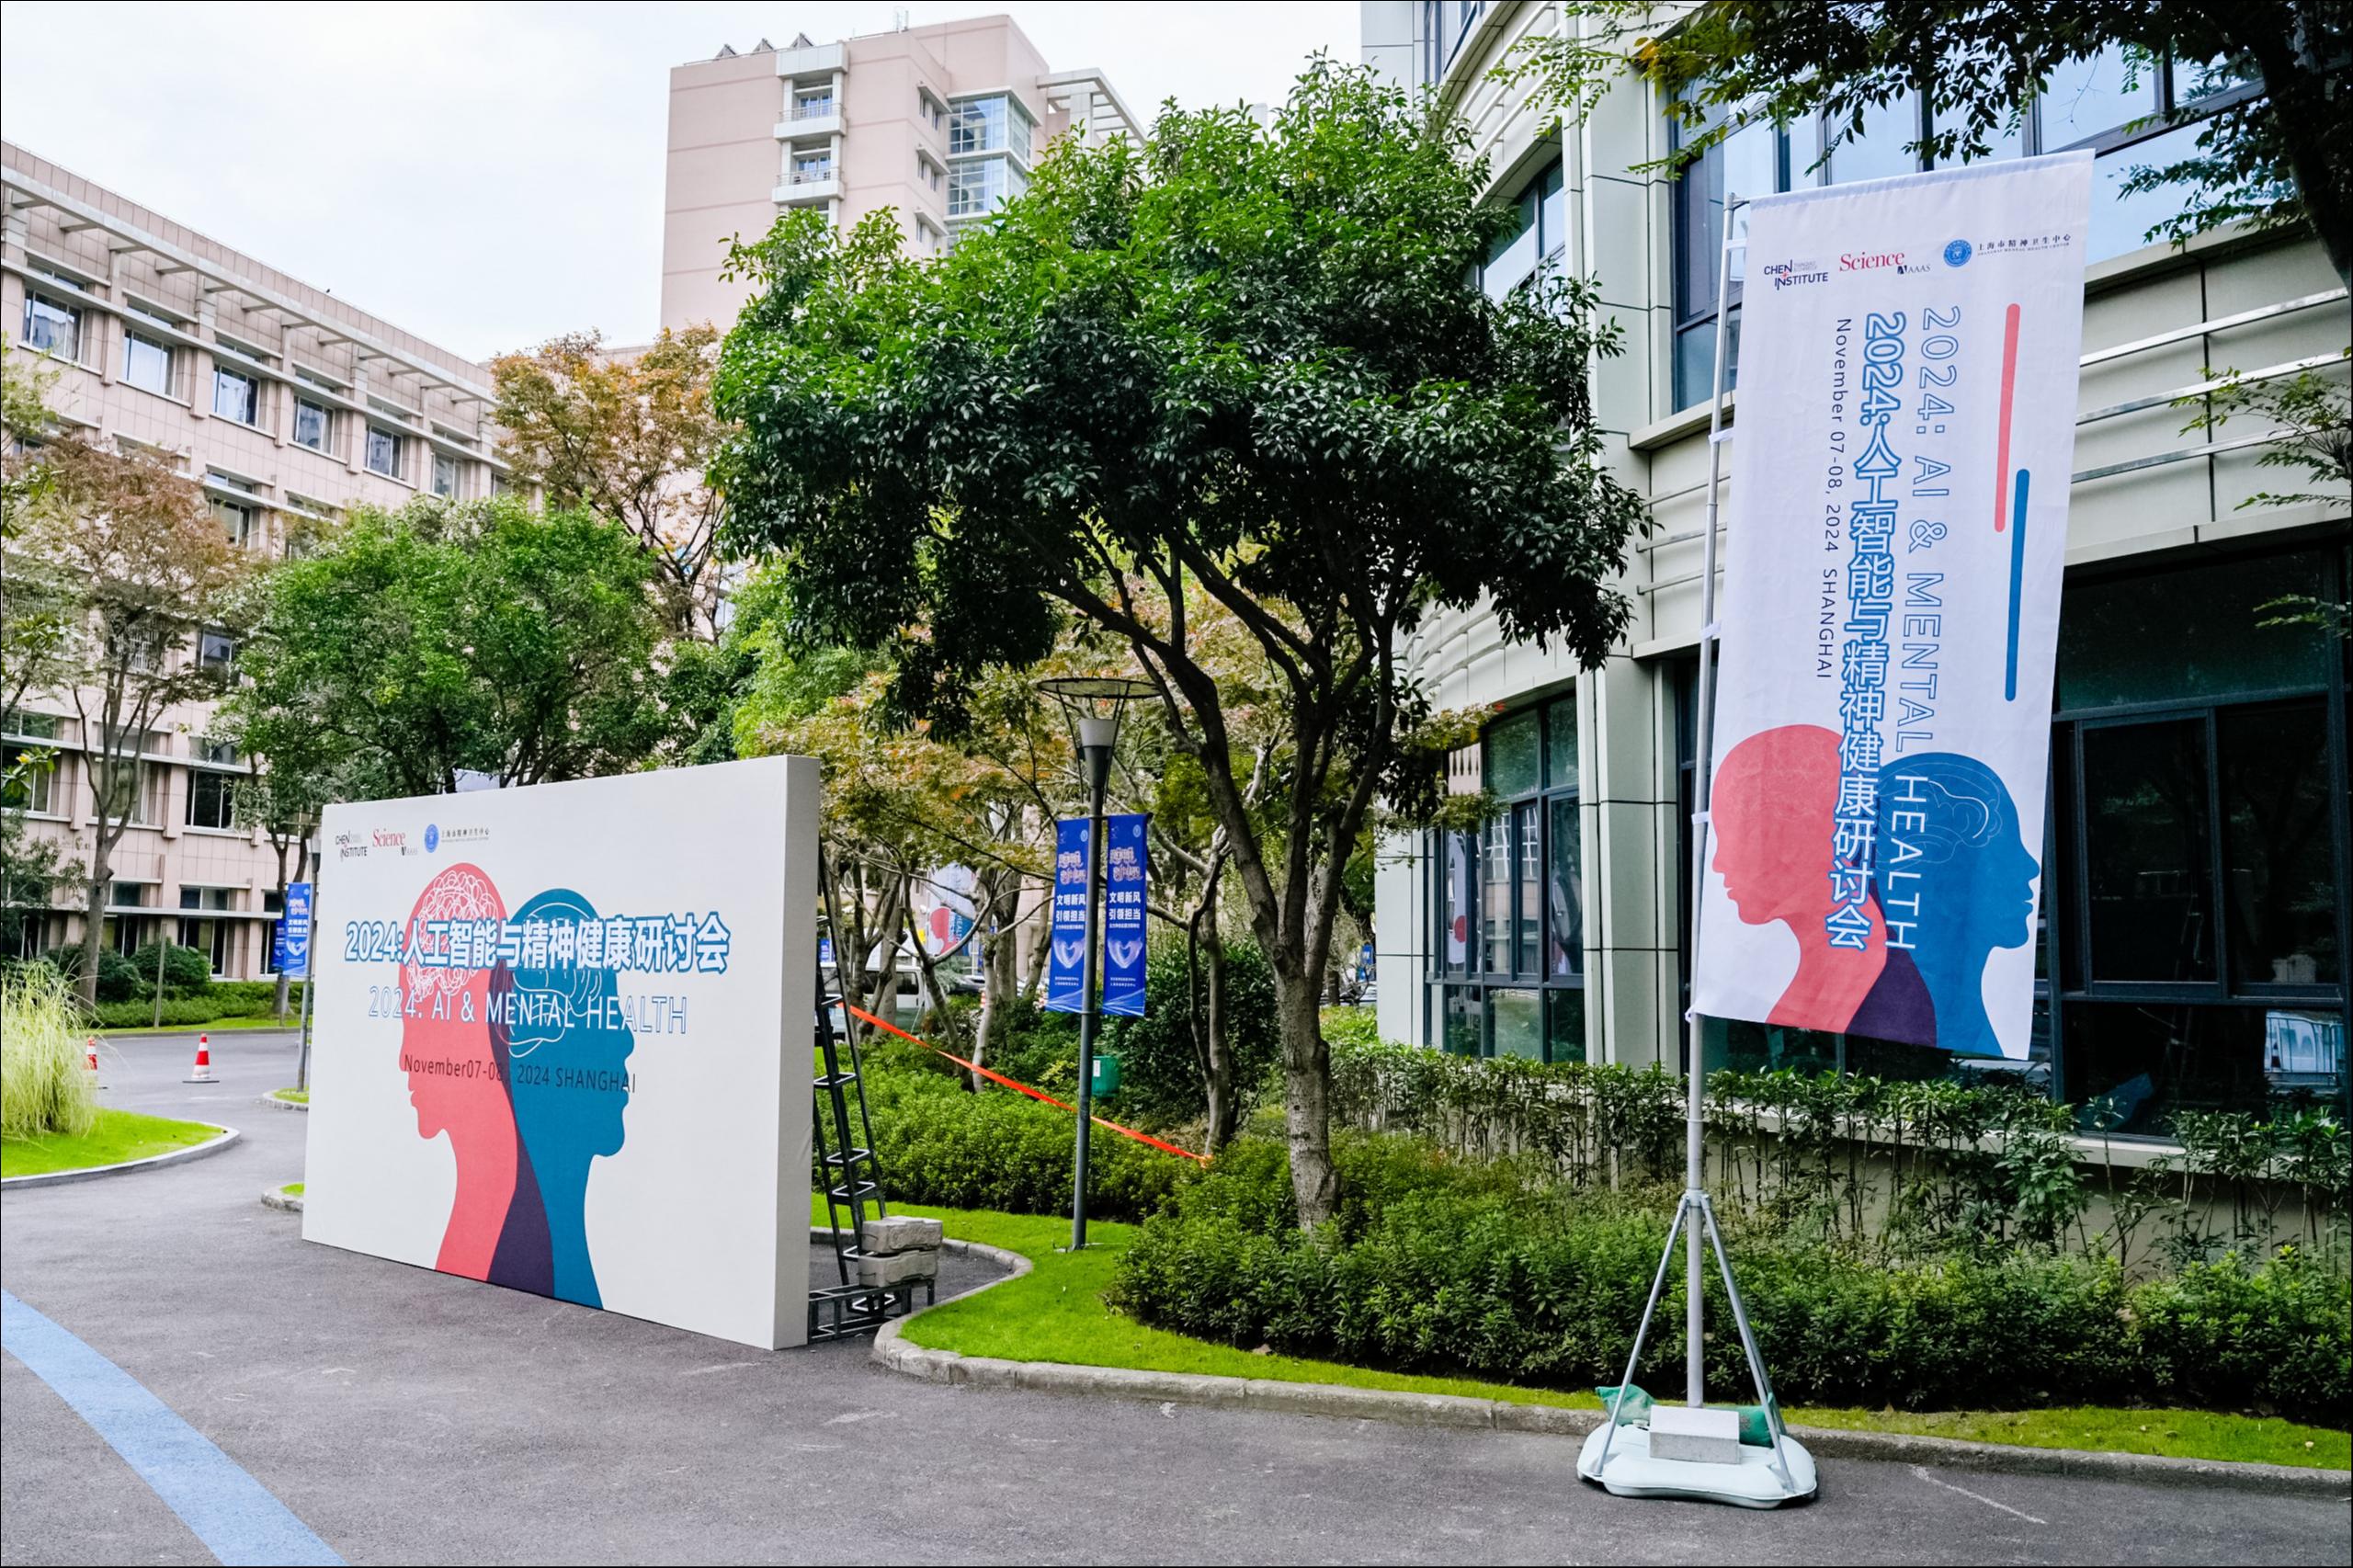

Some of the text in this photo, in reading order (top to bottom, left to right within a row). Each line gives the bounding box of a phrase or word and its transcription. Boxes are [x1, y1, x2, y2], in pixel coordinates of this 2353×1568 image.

[1764, 259, 1793, 275] CHEN
[1838, 252, 1905, 273] Science
[1908, 265, 1932, 274] AAAS
[1774, 272, 1829, 291] INSTITUTE
[1915, 305, 1961, 435] 2024:
[1912, 455, 1951, 497] AI
[1816, 318, 1852, 678] November 07-08, 2024 SHANGHAI
[1908, 519, 1948, 553] &
[1895, 573, 1945, 753] MENTAL
[335, 830, 351, 846] CHEN
[372, 828, 406, 848] Science
[340, 846, 368, 861] INSTITUTE
[1885, 774, 1929, 949] HEALTH
[431, 990, 451, 1021] AI
[460, 991, 476, 1022] &
[485, 992, 575, 1028] MENTAL
[586, 995, 688, 1035] HEALTH
[517, 1064, 551, 1085] 2024
[555, 1067, 636, 1094] SHANGHAI
